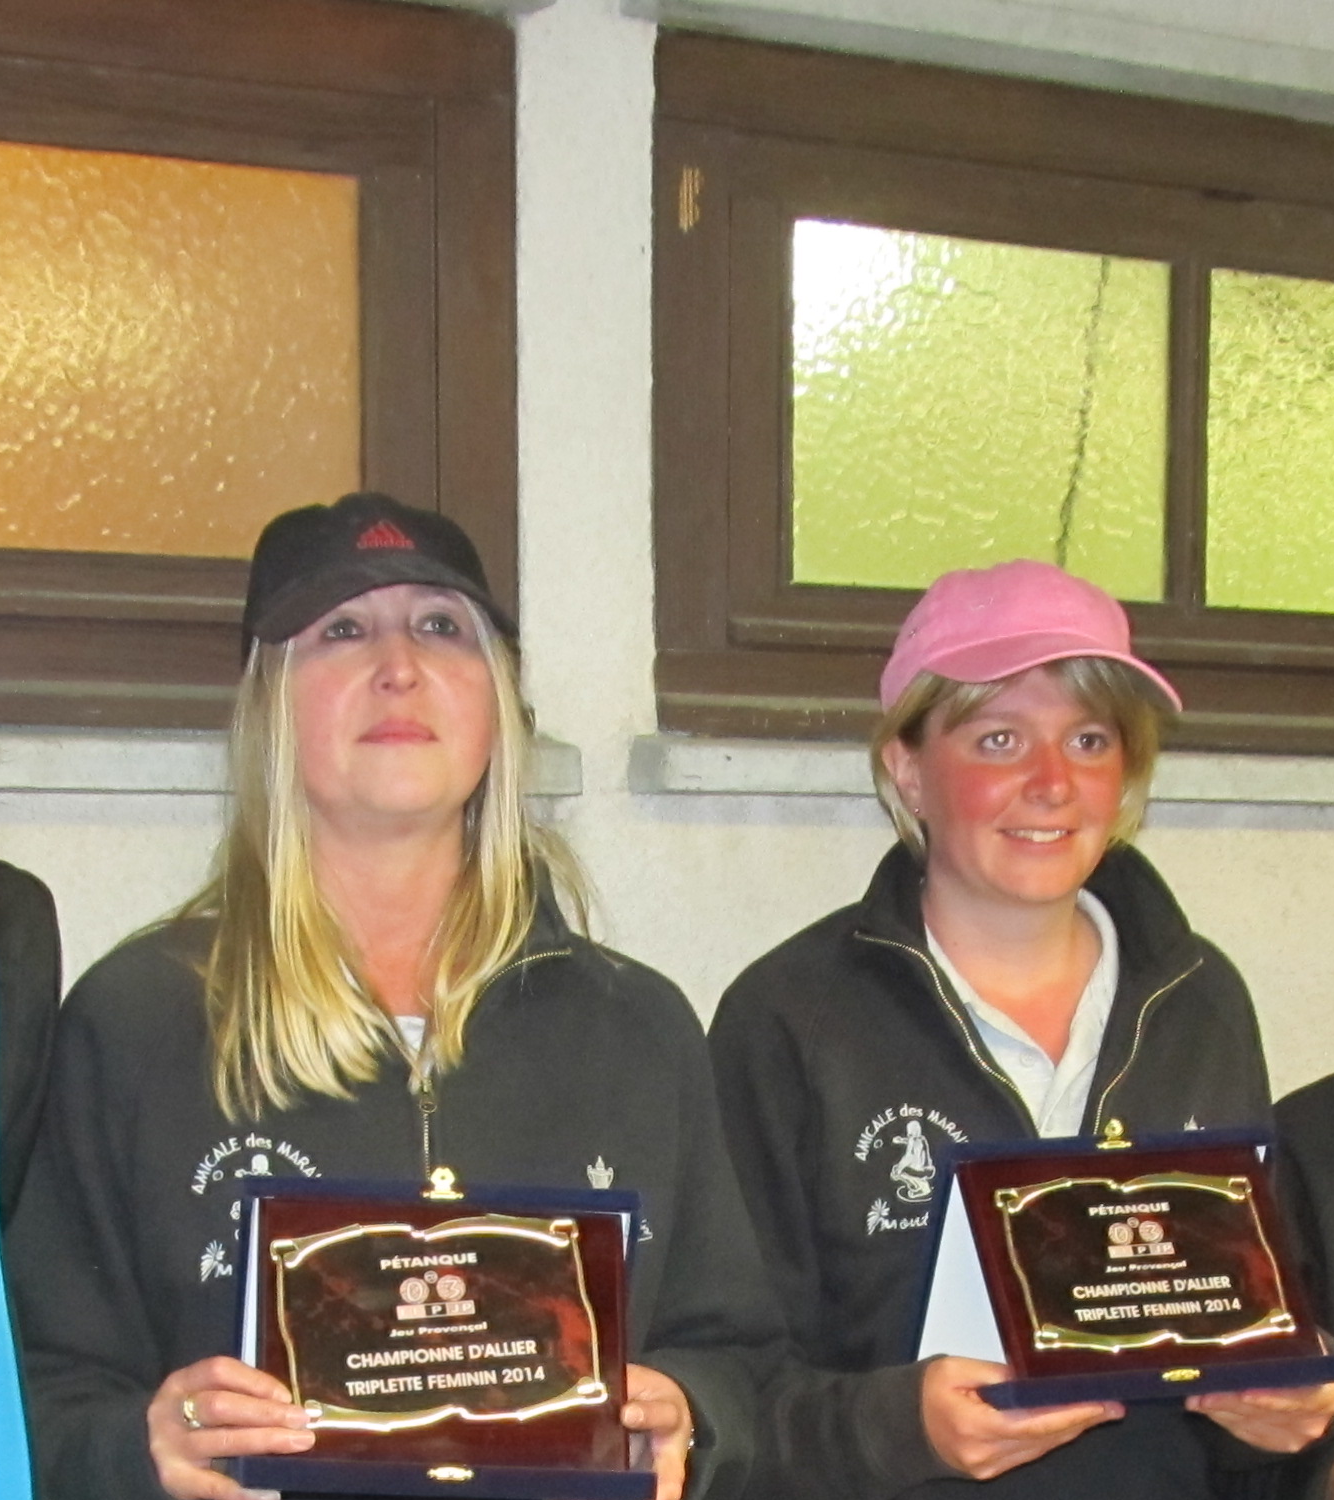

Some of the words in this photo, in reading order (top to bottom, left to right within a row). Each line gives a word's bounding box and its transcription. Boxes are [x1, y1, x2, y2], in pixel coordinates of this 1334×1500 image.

[854, 1108, 897, 1161] AMICALE
[899, 1102, 924, 1118] des
[927, 1110, 969, 1143] MARAI
[191, 1137, 241, 1194] AMICALE
[245, 1132, 272, 1150] des
[1088, 1202, 1170, 1216] PÉTANQUE
[380, 1252, 478, 1270] PÉTANQUE
[1105, 1265, 1126, 1273] Jeu
[1073, 1281, 1170, 1299] CHAMPIONNE
[1174, 1276, 1231, 1292] D'ALLIER
[1075, 1305, 1140, 1322] TRIPLETTE
[1143, 1301, 1202, 1317] FEMININ
[1205, 1298, 1242, 1312] 2014
[389, 1328, 414, 1338] Jeu
[347, 1346, 464, 1369] CHAMPIONNE
[469, 1340, 537, 1359] D'ALLIER
[346, 1376, 423, 1397] TRIPLETTE
[427, 1370, 497, 1389] FEMININ
[503, 1366, 545, 1383] 2014
